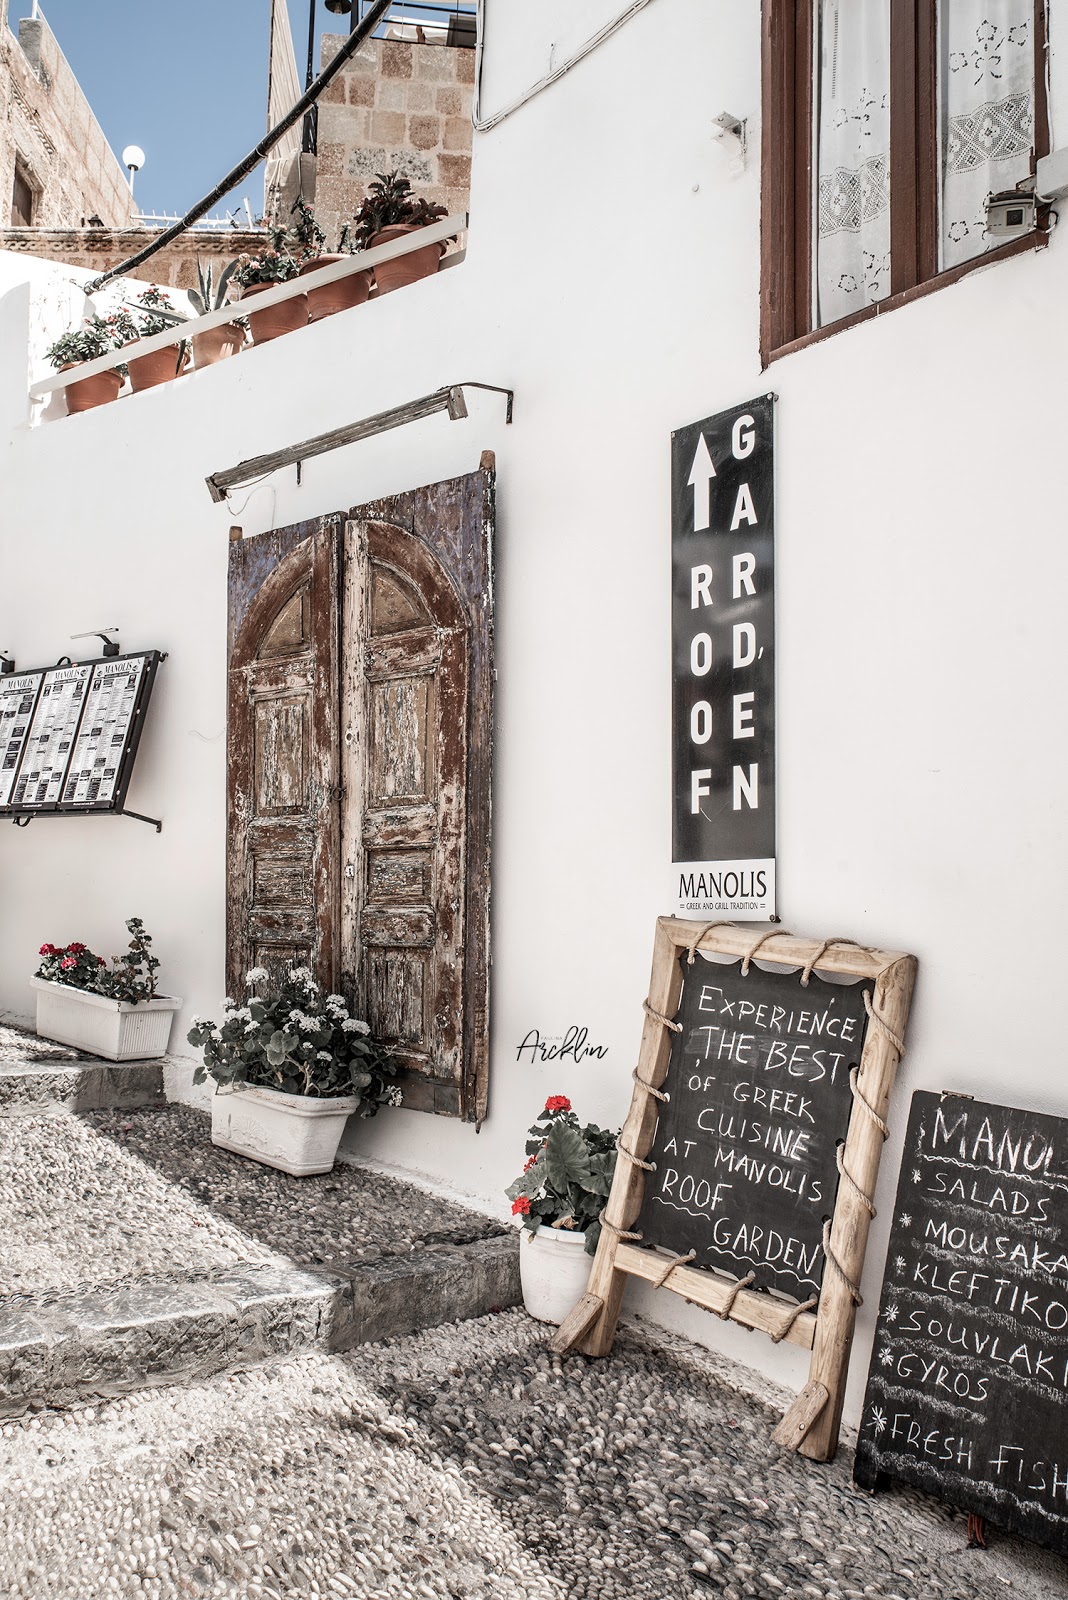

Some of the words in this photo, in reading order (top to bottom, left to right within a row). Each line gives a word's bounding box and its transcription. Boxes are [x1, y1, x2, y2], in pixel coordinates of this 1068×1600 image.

[730, 414, 758, 811] GARDEN
[8, 678, 34, 690] MANOLIS
[55, 668, 81, 680] MANOLIS
[105, 661, 132, 673] MANOLIS
[690, 563, 713, 815] ROOF
[679, 870, 767, 898] MANOLIS
[686, 902, 701, 910] GREEK
[702, 902, 714, 910] AND
[715, 902, 729, 910] GRILL
[730, 902, 758, 910] TRADITION
[698, 985, 858, 1042] EXPERIENCE
[699, 1026, 755, 1064] THE
[764, 1040, 846, 1085] BEST
[688, 1075, 716, 1092] OF
[733, 1082, 815, 1124] GREEK
[697, 1108, 811, 1161] CUISINE
[661, 1168, 733, 1211] ROOF
[663, 1136, 698, 1158] AT
[714, 1148, 822, 1202] MANOLIS
[927, 1172, 1051, 1222] SALADS
[713, 1217, 821, 1275] GARDEN
[924, 1218, 1068, 1274] MOUSAKA
[914, 1262, 1068, 1330] KLEFTIKO
[898, 1310, 1068, 1388] SOUVLAKI
[896, 1353, 990, 1402] GYROS
[890, 1413, 973, 1471] FRESH
[988, 1445, 1068, 1498] FISH
